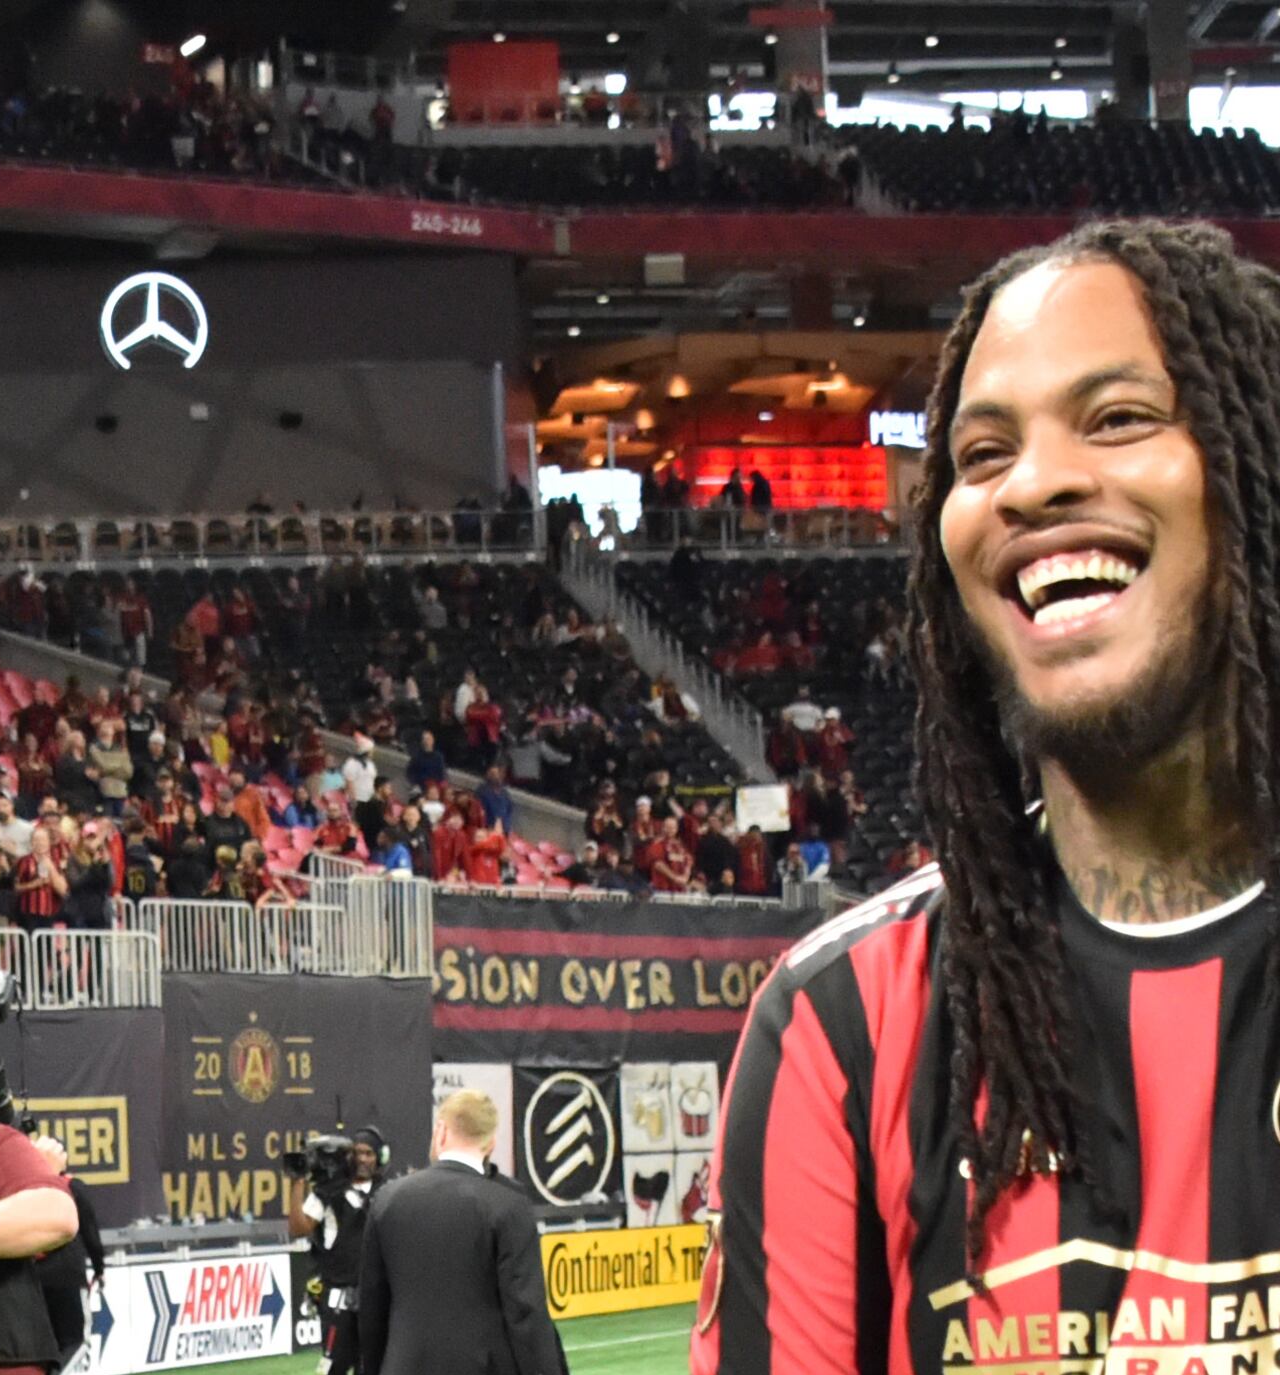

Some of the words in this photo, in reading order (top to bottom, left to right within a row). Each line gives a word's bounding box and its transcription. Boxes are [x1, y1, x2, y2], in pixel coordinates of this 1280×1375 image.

[560, 957, 675, 1010] OVER
[194, 1052, 221, 1081] 20
[287, 1051, 312, 1080] 18
[188, 1131, 248, 1161] MLS
[265, 1130, 320, 1161] CU
[162, 1169, 292, 1220] HAMPI
[180, 1261, 268, 1326] ARROW
[547, 1235, 660, 1312] Continental
[175, 1323, 265, 1361] EXTERMINATORS
[941, 1296, 1187, 1362] AMERIAN
